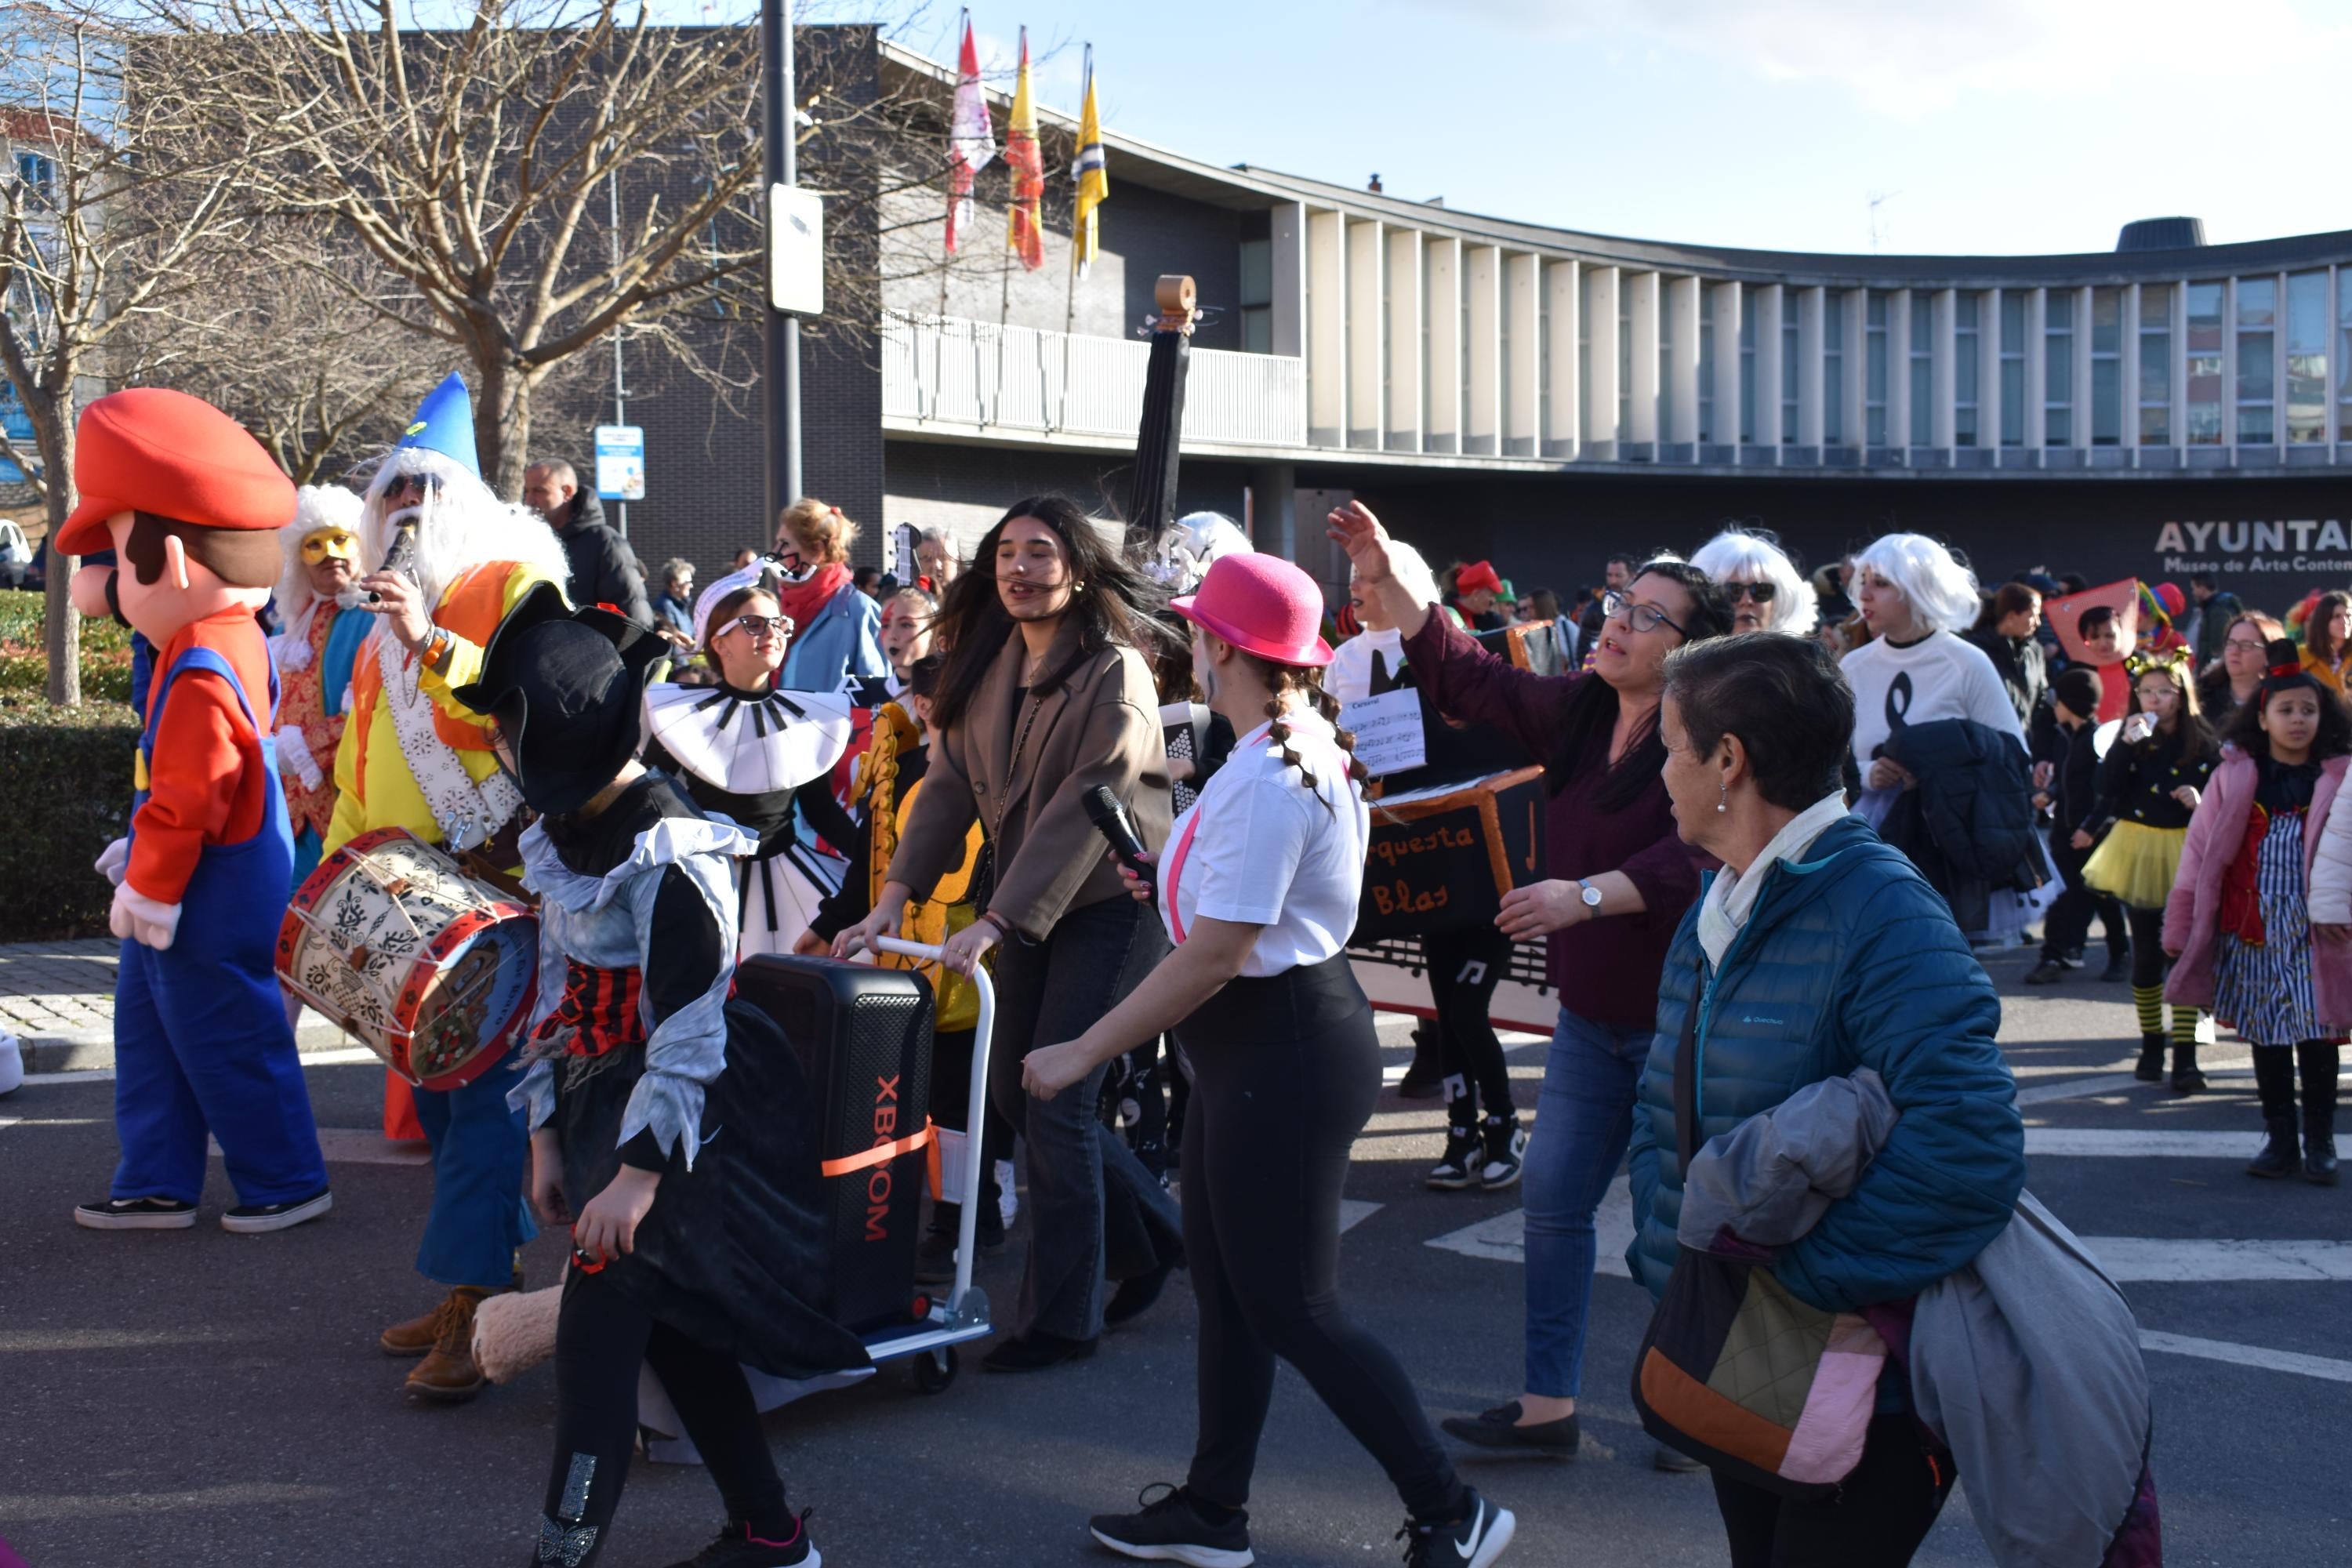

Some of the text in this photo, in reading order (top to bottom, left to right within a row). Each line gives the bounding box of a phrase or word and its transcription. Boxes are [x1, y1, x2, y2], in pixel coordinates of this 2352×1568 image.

[2154, 519, 2352, 552] AYUNTA
[2164, 556, 2219, 572] Museo
[2223, 559, 2244, 572] de
[2249, 555, 2289, 572] Arte
[1366, 826, 1474, 866] rquesta
[1371, 879, 1449, 916] Blas
